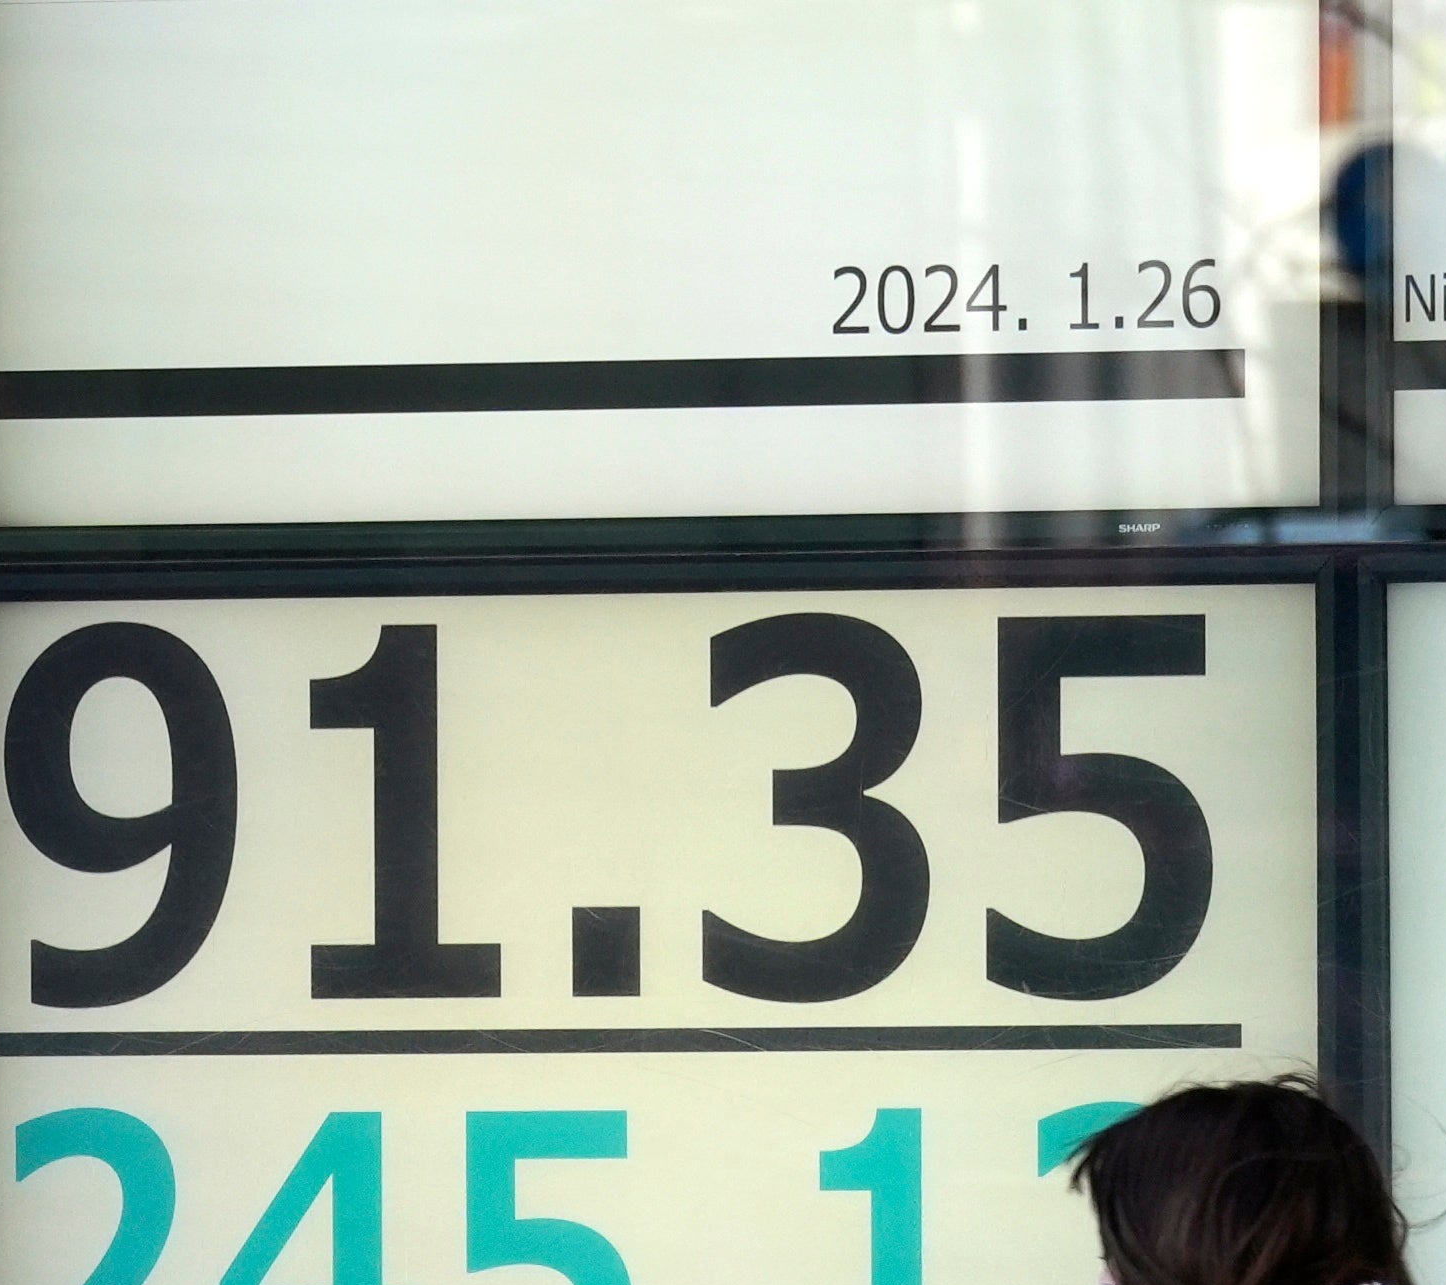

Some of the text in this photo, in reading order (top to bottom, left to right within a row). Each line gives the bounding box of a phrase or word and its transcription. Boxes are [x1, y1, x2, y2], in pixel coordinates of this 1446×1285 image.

[831, 259, 1222, 335] 2024. 1.26
[1119, 523, 1160, 533] SHARP
